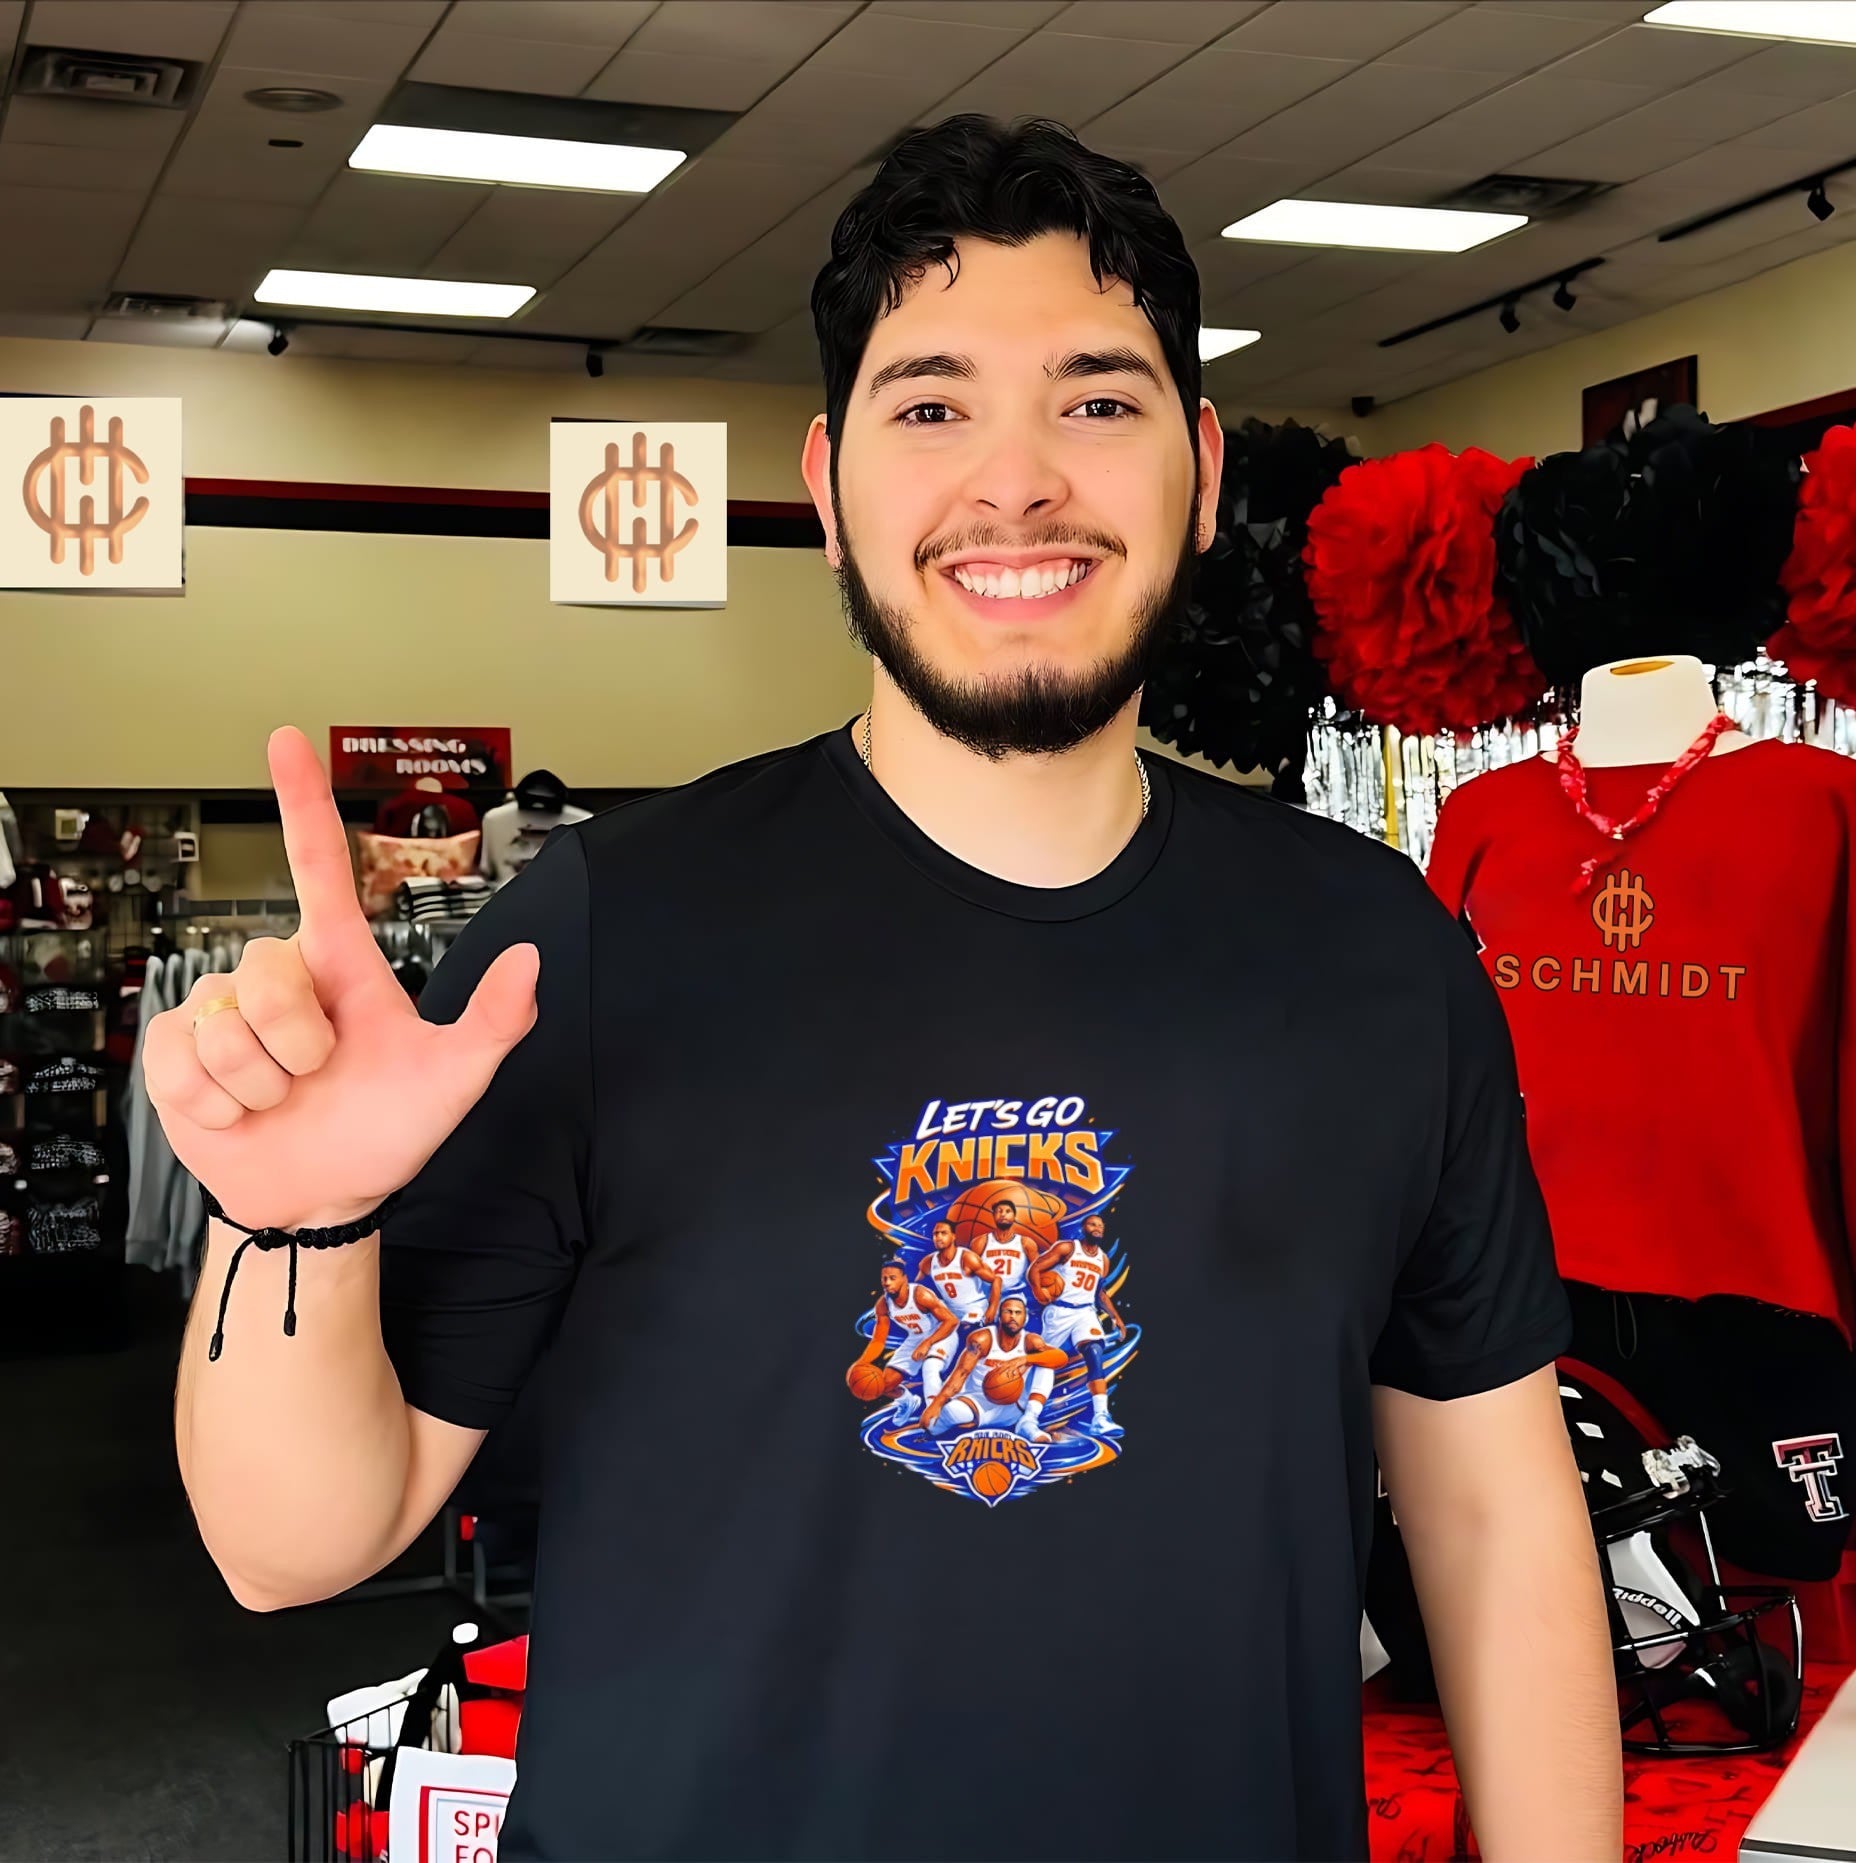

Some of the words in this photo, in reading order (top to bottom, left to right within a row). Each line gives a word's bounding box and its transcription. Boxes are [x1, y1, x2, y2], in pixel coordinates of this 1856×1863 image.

[342, 737, 467, 754] DRESSING
[396, 758, 487, 774] ROOMS
[1494, 953, 1747, 1000] SCHMIDT
[916, 1099, 1023, 1141] LET'S
[1026, 1096, 1085, 1128] GO
[895, 1131, 1105, 1204] KNICKS
[993, 1259, 1011, 1276] 21
[1072, 1271, 1096, 1292] 30
